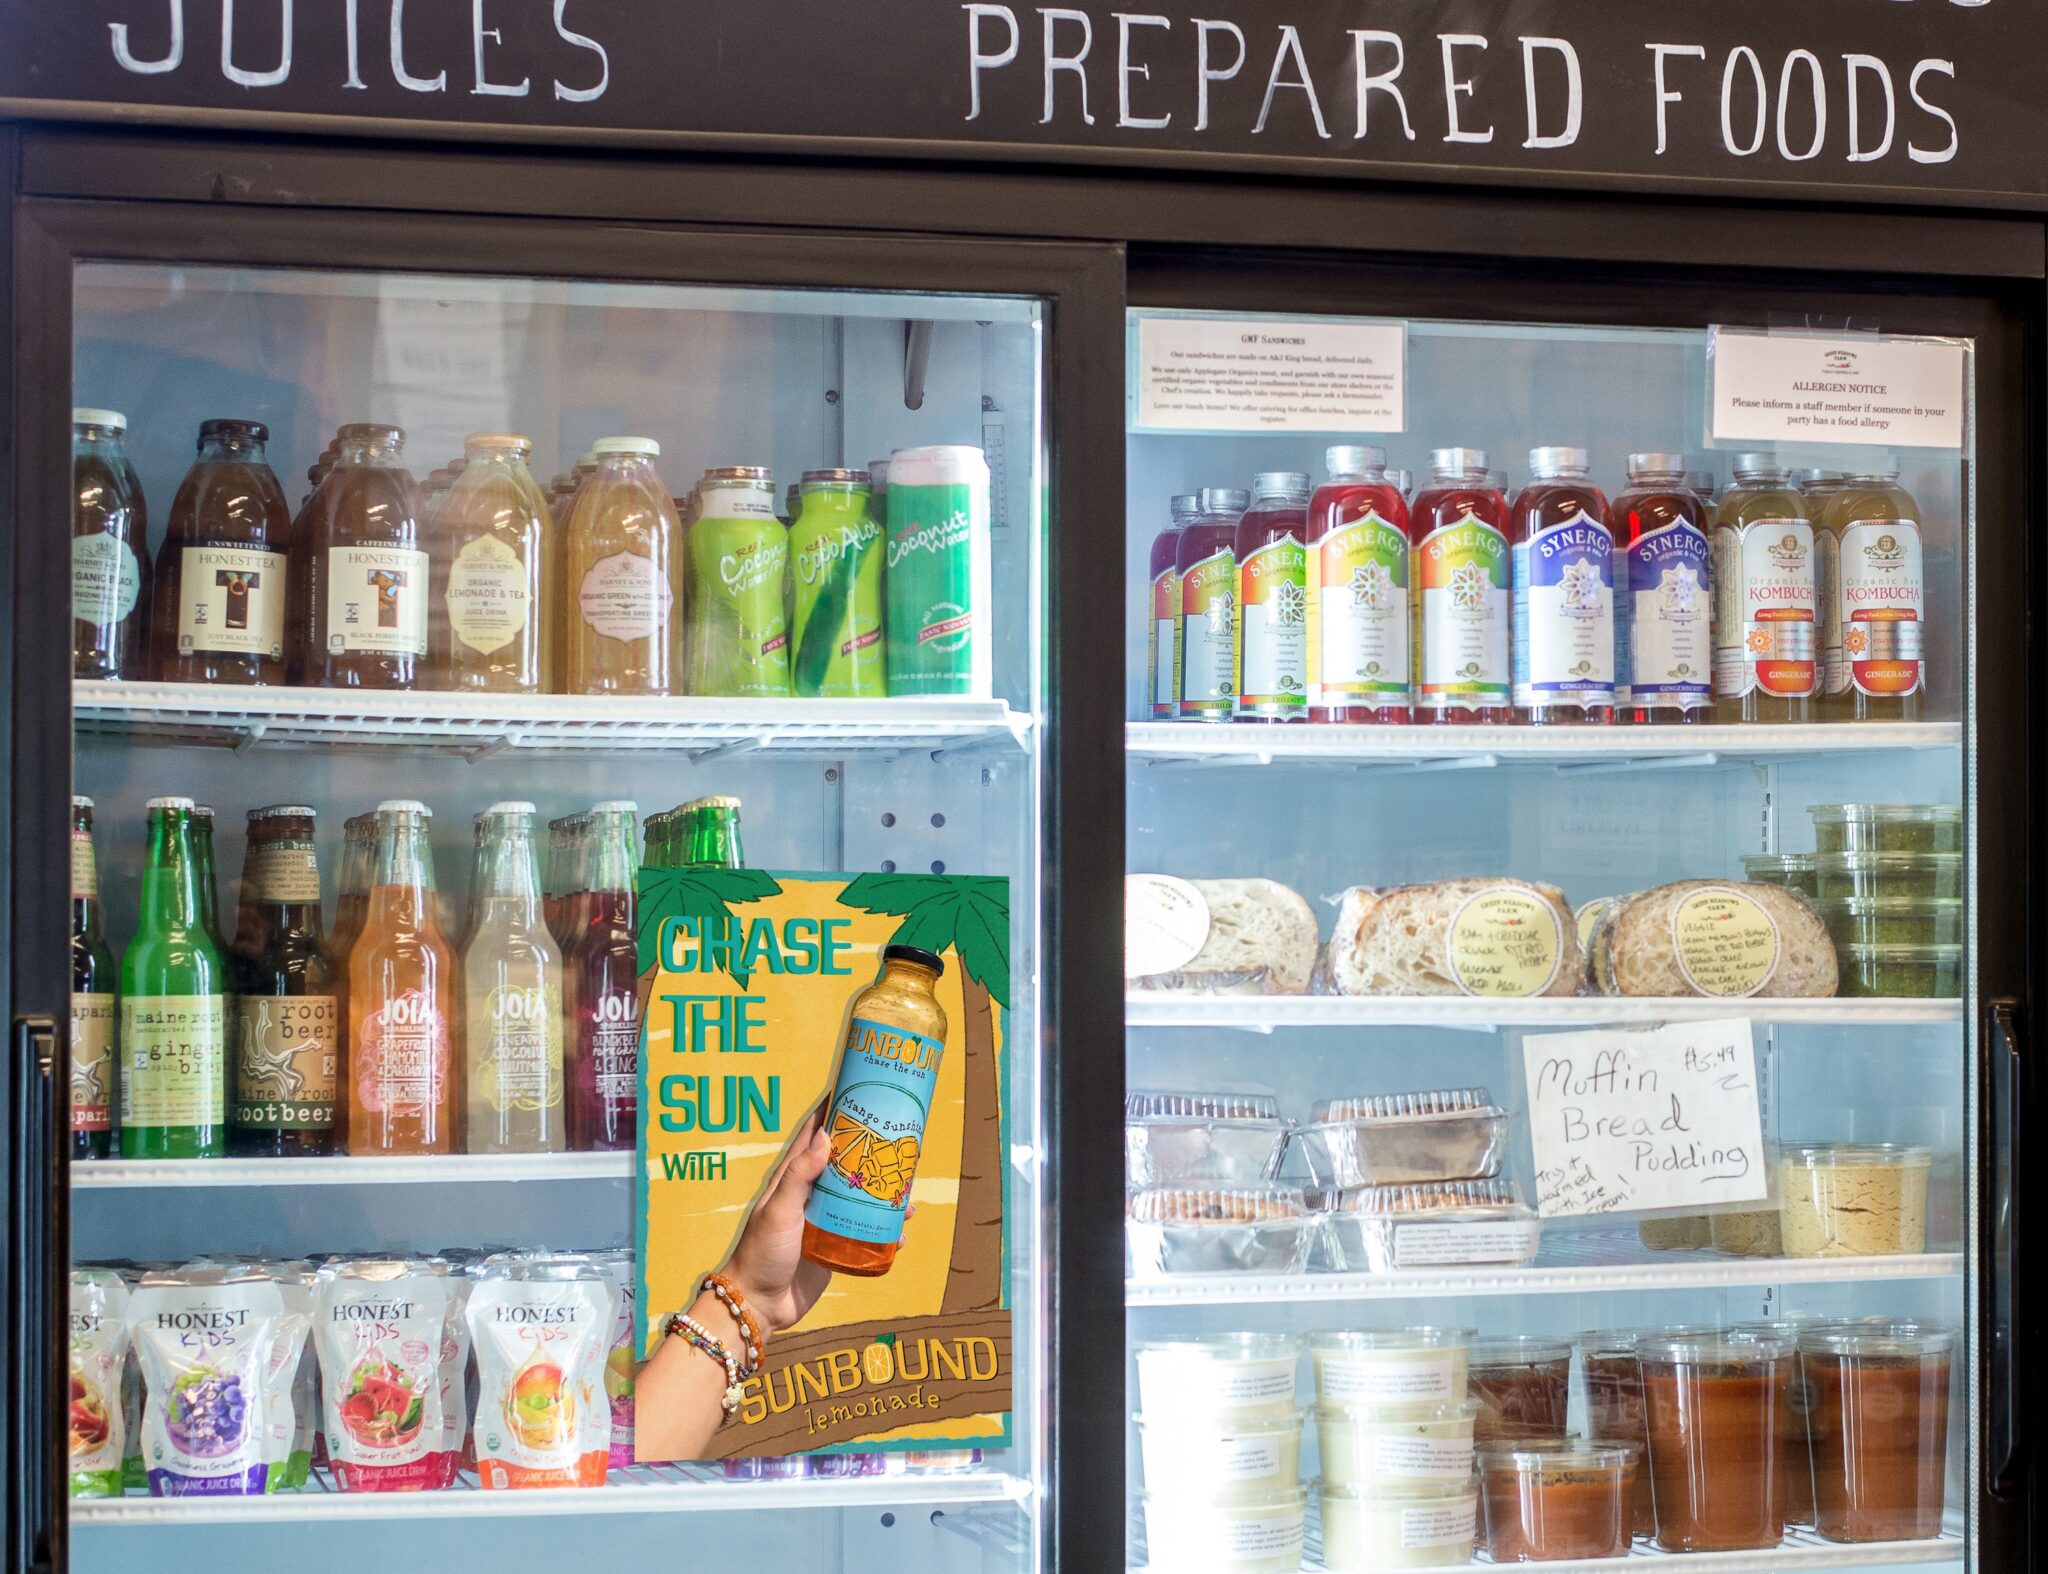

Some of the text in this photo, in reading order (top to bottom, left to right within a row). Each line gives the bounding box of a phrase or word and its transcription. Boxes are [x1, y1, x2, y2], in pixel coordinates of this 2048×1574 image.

[108, 0, 609, 102] JUICES
[961, 3, 1958, 164] PREPARED FOODS
[1241, 334, 1259, 344] GMF
[1792, 381, 1887, 395] ALLERGEN NOTICE
[1732, 397, 1760, 408] Please
[1762, 399, 1794, 409] inform
[1803, 400, 1823, 411] staff
[1825, 402, 1862, 413] member
[1864, 403, 1872, 413] if
[1872, 406, 1912, 415] someone
[1914, 405, 1923, 415] in
[1925, 409, 1946, 418] your
[1787, 414, 1811, 426] party
[1813, 415, 1828, 424] has
[1838, 416, 1858, 426] food
[1860, 417, 1890, 429] allergy
[887, 510, 968, 568] Coconut
[1330, 530, 1404, 560] SYNERGY
[1430, 531, 1505, 559] SYNERGY
[1540, 529, 1611, 558] SYNERGY
[1640, 534, 1708, 562] SYNERGY
[199, 553, 276, 569] HONEST TEA
[348, 553, 400, 564] HONEST
[1250, 551, 1305, 577] SYNER
[467, 579, 503, 587] ORGANIC
[1191, 564, 1235, 588] SYNE
[449, 589, 525, 599] LEMONADE & TEA
[1750, 586, 1815, 602] KOMBUCH
[1846, 587, 1920, 602] KOMBUCHA
[658, 915, 852, 975] CHASE
[135, 1011, 187, 1024] maine
[281, 1003, 334, 1019] root
[281, 1021, 334, 1039] beer
[659, 994, 767, 1053] THE
[150, 1040, 222, 1061] ginger
[592, 1047, 637, 1056] POMEGRA
[604, 1056, 637, 1073] GING
[863, 1055, 927, 1079] chase the sun
[1537, 1049, 1657, 1100] Muffin
[281, 1102, 334, 1122] beer
[659, 1074, 781, 1133] SUN
[842, 1096, 925, 1137] Mango Sunshin
[1561, 1093, 1691, 1143] Bread
[1536, 1156, 1581, 1187] Try it
[1628, 1140, 1749, 1183] Pudding
[1538, 1164, 1597, 1204] warmed
[1547, 1186, 1605, 1216] with Ice
[826, 1211, 838, 1220] made
[840, 1217, 853, 1225] with
[158, 1309, 250, 1330] HONEST
[332, 1302, 415, 1322] HONEST
[495, 1306, 578, 1323] HONEST
[740, 1335, 999, 1425] SUNBOUND
[804, 1385, 941, 1435] lemonade
[207, 1478, 230, 1489] JUICE
